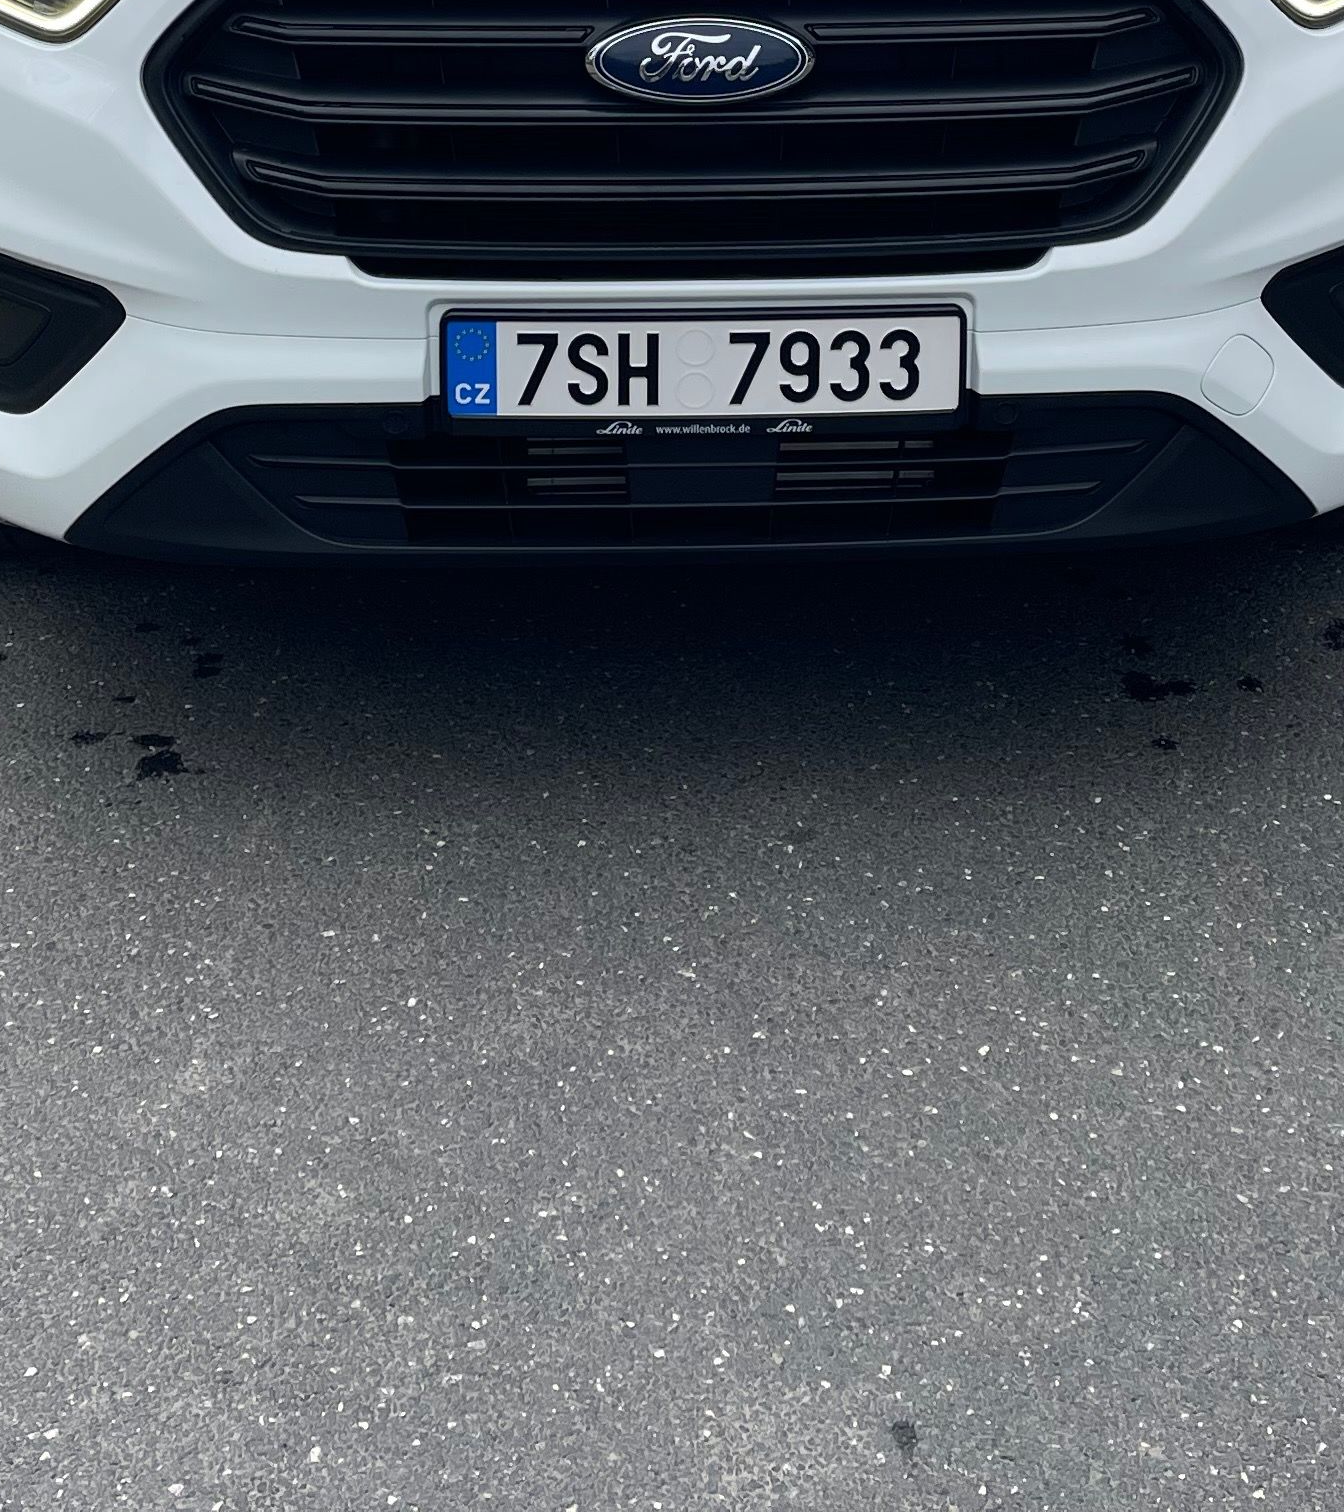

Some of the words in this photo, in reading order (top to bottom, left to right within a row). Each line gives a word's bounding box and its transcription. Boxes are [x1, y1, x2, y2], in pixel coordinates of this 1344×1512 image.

[639, 31, 761, 82] Ford
[516, 331, 660, 407] 7SH
[728, 329, 921, 406] 7933
[455, 383, 491, 405] CZ
[596, 420, 643, 435] Linde
[656, 423, 751, 434] www.willenbrock.de
[766, 418, 813, 433] Linde
